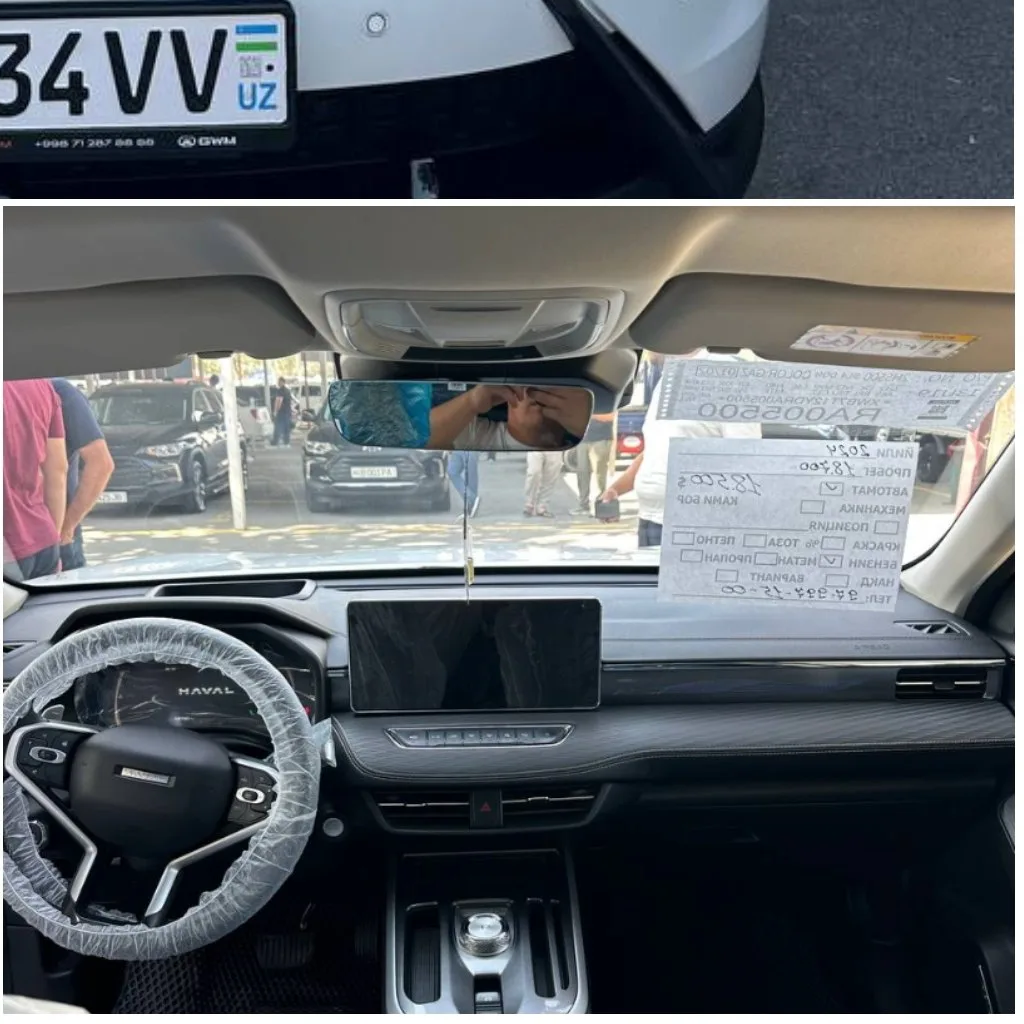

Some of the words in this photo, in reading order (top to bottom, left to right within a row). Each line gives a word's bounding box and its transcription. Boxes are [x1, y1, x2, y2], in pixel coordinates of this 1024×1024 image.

[236, 82, 277, 111] UZ
[197, 136, 237, 147] GWM
[178, 686, 235, 695] HAVAL
